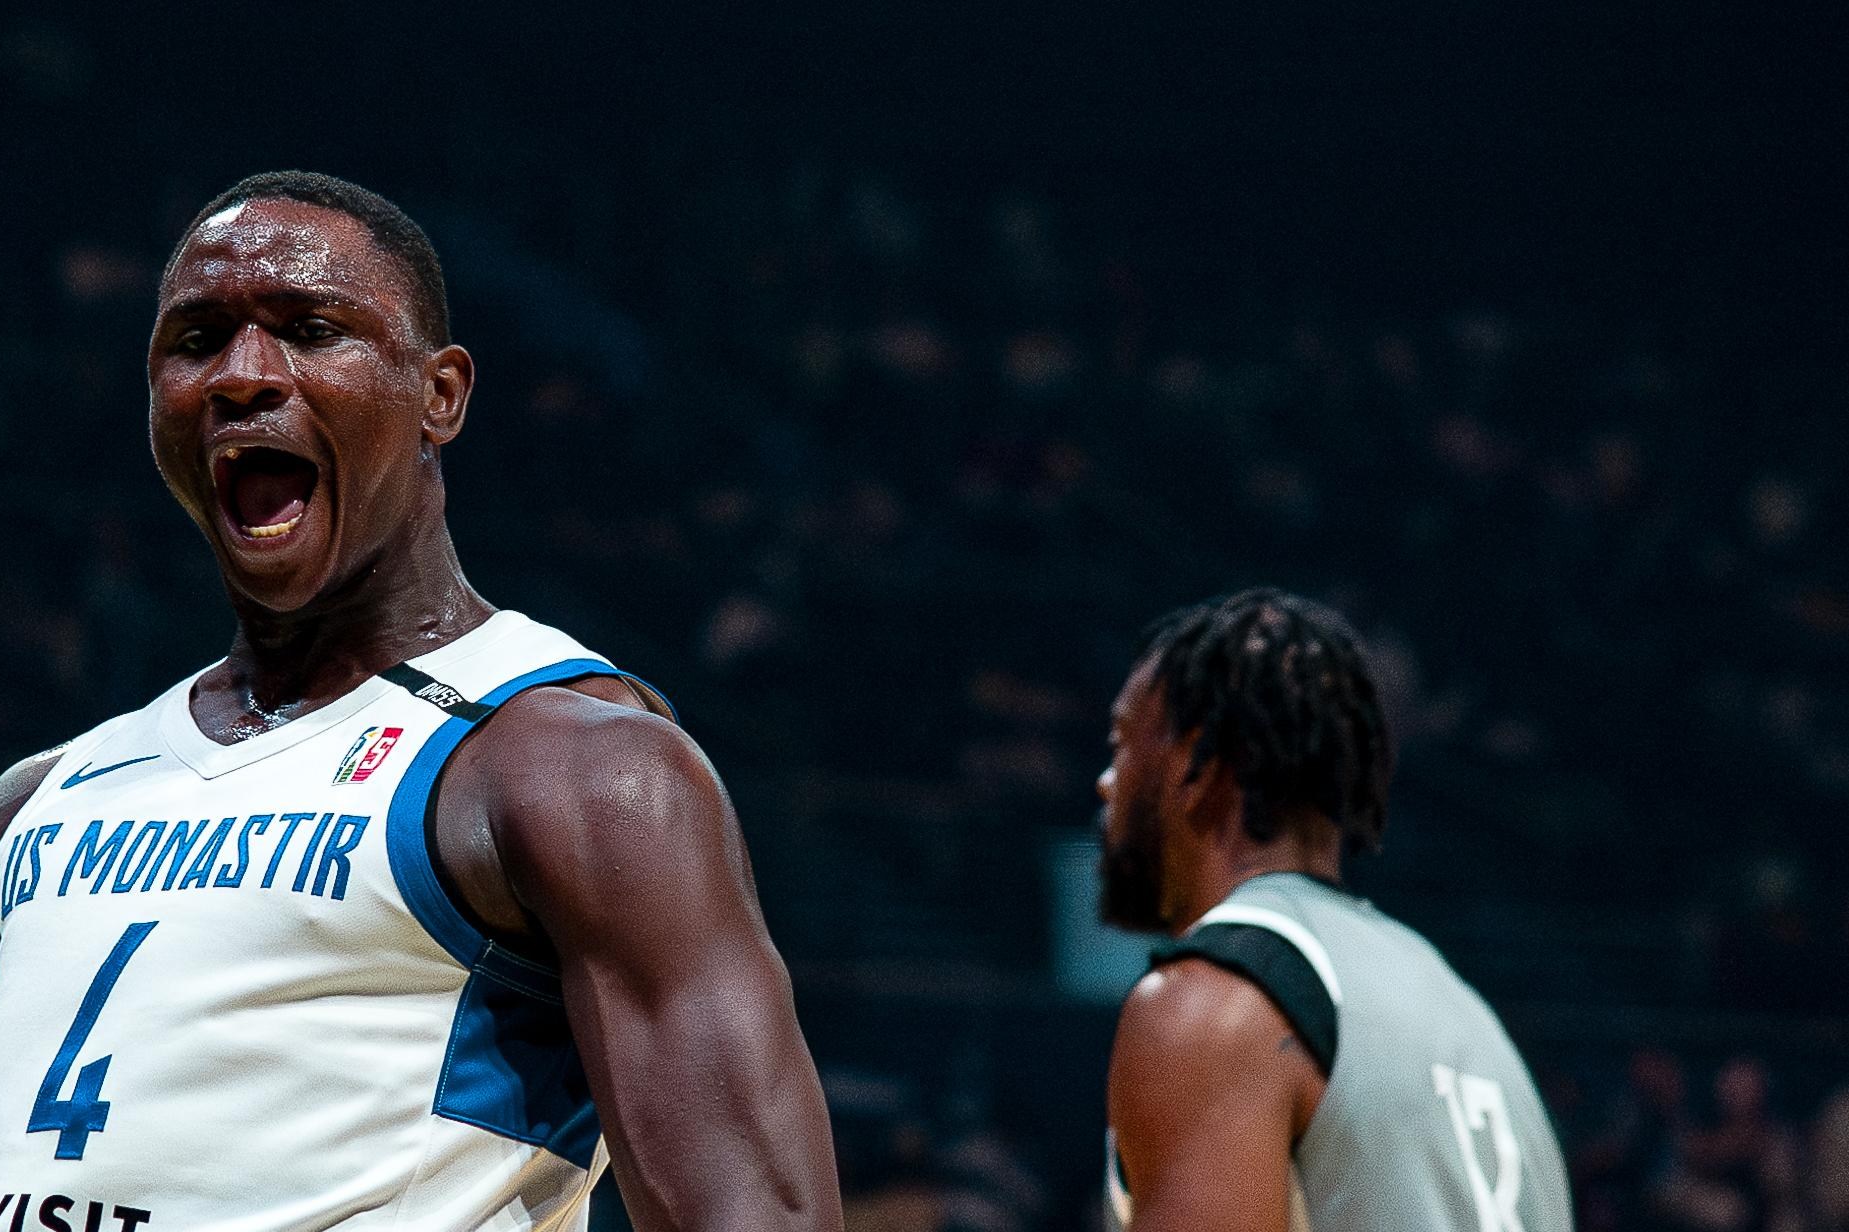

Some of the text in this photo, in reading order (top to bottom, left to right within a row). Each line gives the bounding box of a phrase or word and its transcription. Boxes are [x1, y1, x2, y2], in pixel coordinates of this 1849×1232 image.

[1, 812, 371, 921] US MONASTIR
[26, 921, 160, 1160] 4
